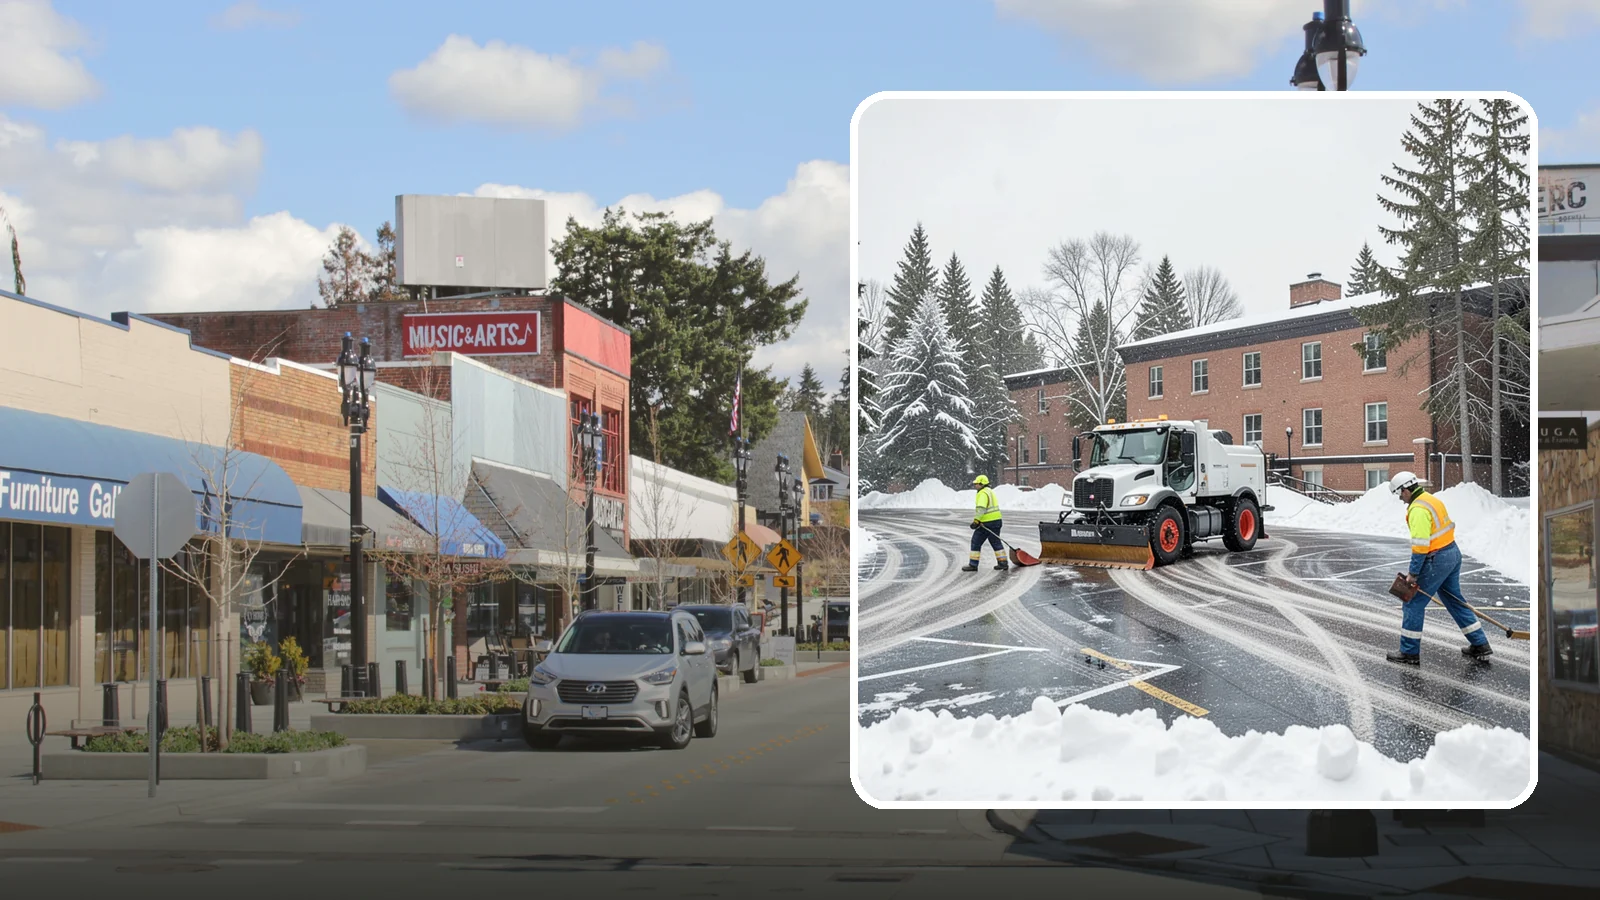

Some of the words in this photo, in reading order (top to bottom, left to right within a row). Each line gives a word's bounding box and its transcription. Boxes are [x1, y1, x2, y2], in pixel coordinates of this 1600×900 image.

[409, 323, 520, 349] MUSIC&ARTS
[1540, 427, 1577, 437] UGA
[0, 471, 79, 515] Furniture
[90, 482, 122, 519] Gal
[452, 563, 480, 574] SUSHI
